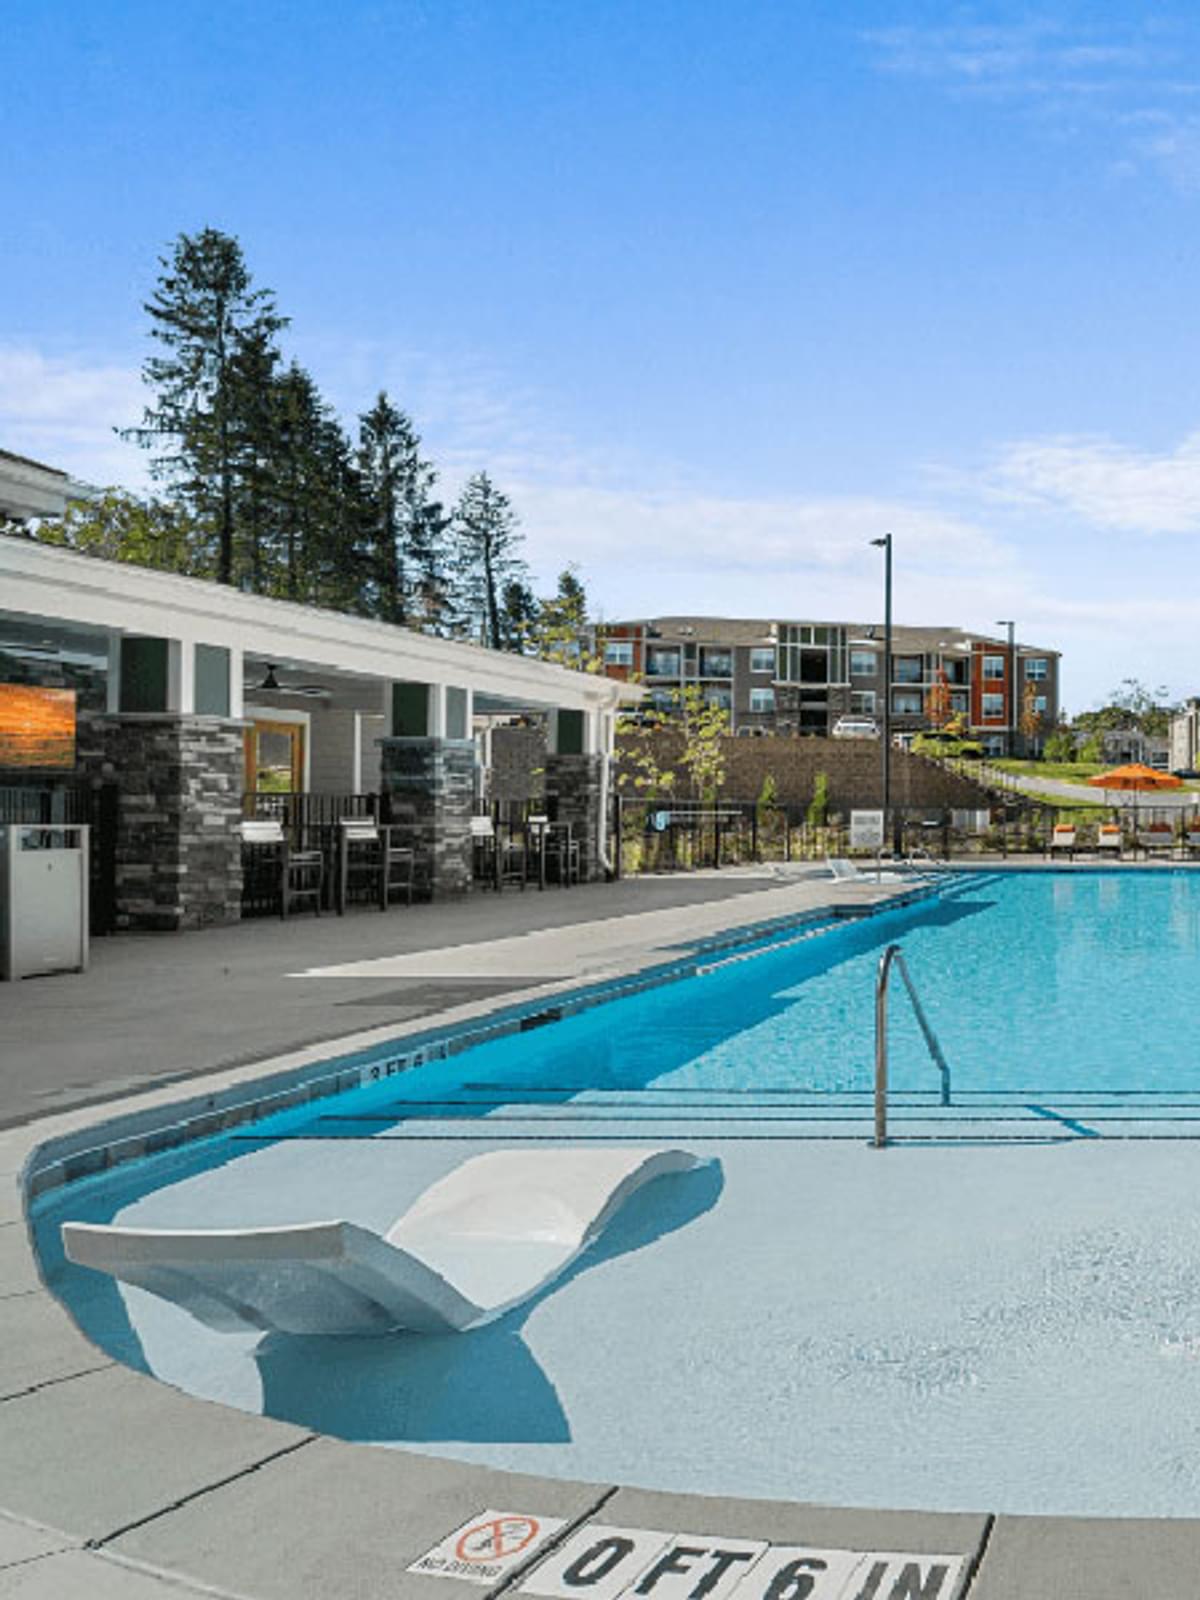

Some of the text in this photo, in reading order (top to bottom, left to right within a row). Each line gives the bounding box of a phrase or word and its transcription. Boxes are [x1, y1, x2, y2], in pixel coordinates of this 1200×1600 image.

[634, 1546, 754, 1600] FT
[762, 1557, 828, 1600] 6
[852, 1560, 951, 1600] IN
